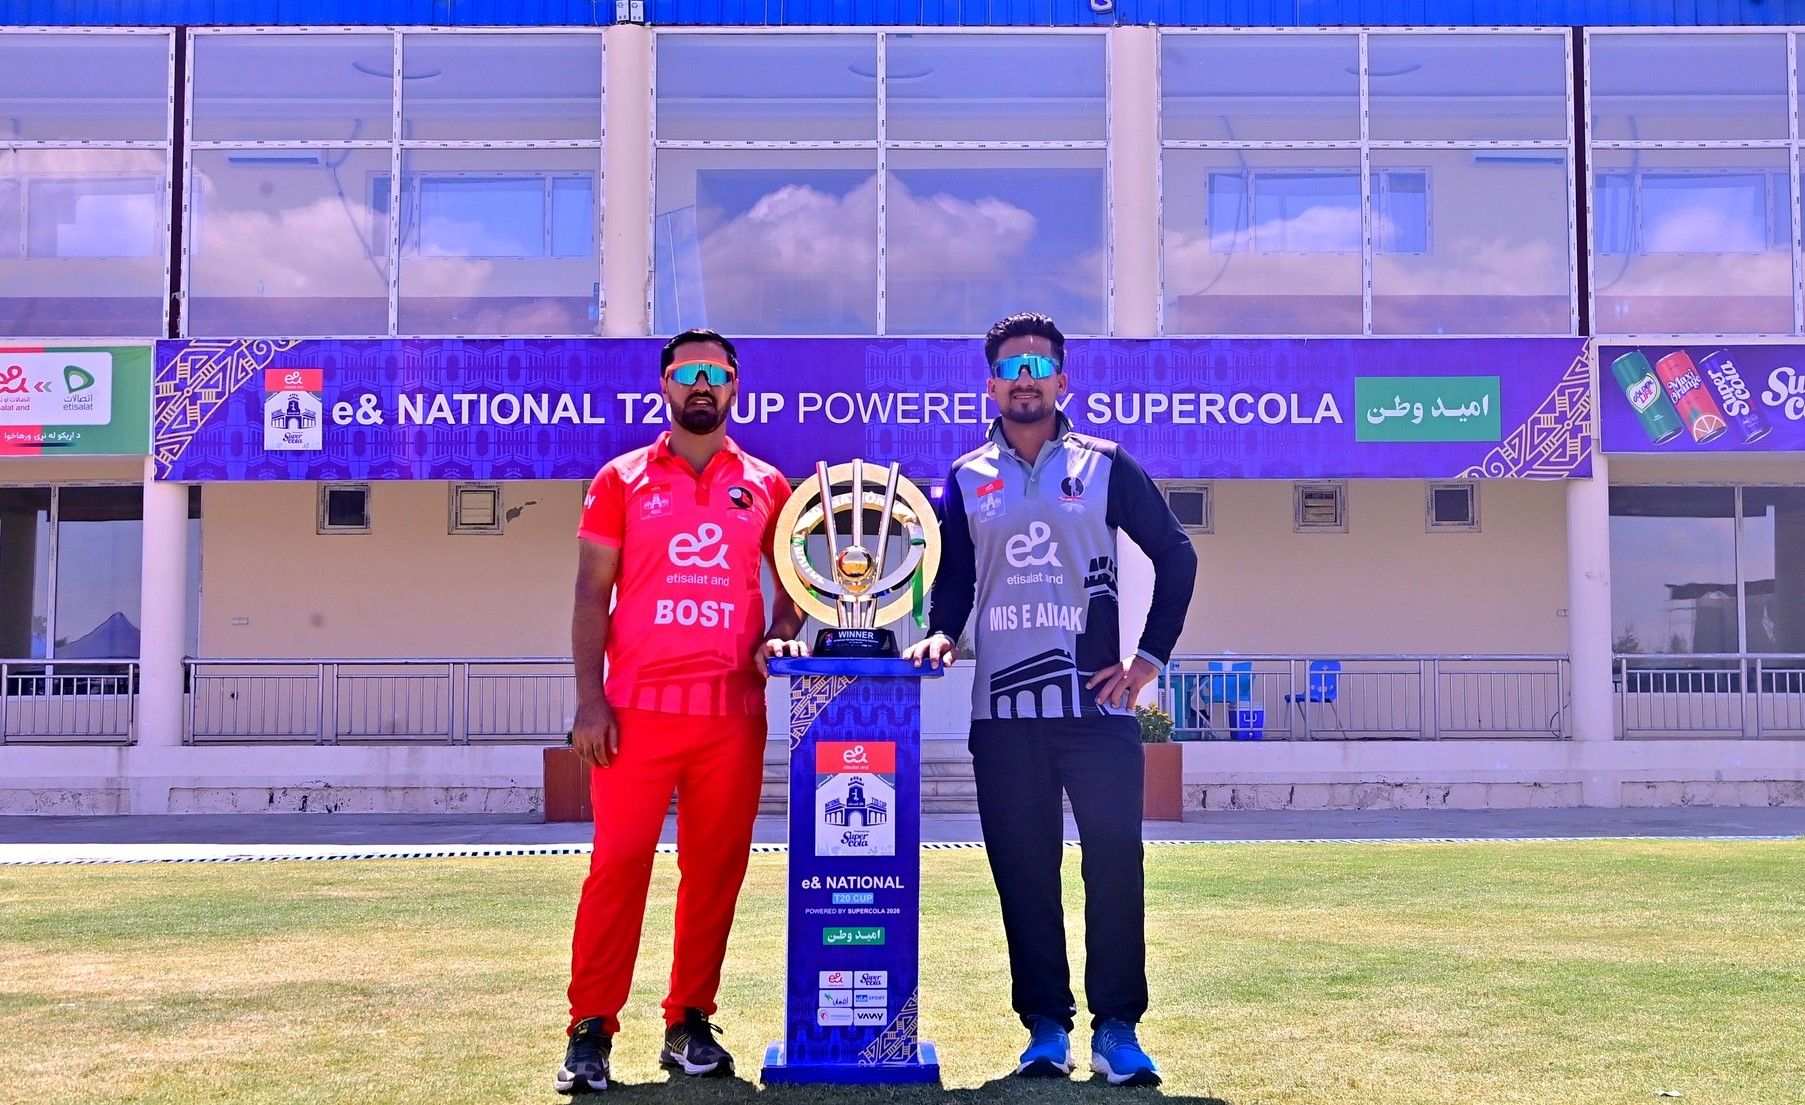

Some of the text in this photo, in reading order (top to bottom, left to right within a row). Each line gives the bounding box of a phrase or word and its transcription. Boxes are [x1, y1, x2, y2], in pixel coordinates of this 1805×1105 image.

[1666, 368, 1696, 392] Maxi
[1670, 375, 1702, 405] Orange
[1707, 369, 1750, 417] Super
[1720, 360, 1751, 400] Cola
[63, 402, 94, 411] etisalat
[332, 393, 384, 425] e&
[398, 393, 605, 424] NATIONAL
[730, 392, 785, 424] UP
[1086, 393, 1343, 424] SUPERCOLA
[1366, 394, 1489, 424] امید وطن
[667, 522, 731, 570] e&
[1005, 521, 1062, 568] e&
[666, 573, 730, 587] etisalat and
[1006, 571, 1043, 585] etisalat
[653, 598, 735, 629] BOST
[989, 604, 1018, 632] MIS
[1022, 603, 1032, 629] E
[838, 630, 874, 640] WINNER
[843, 745, 868, 763] e&
[841, 831, 868, 844] Super
[801, 876, 904, 890] e& NATIONAL
[852, 894, 873, 902] CUP
